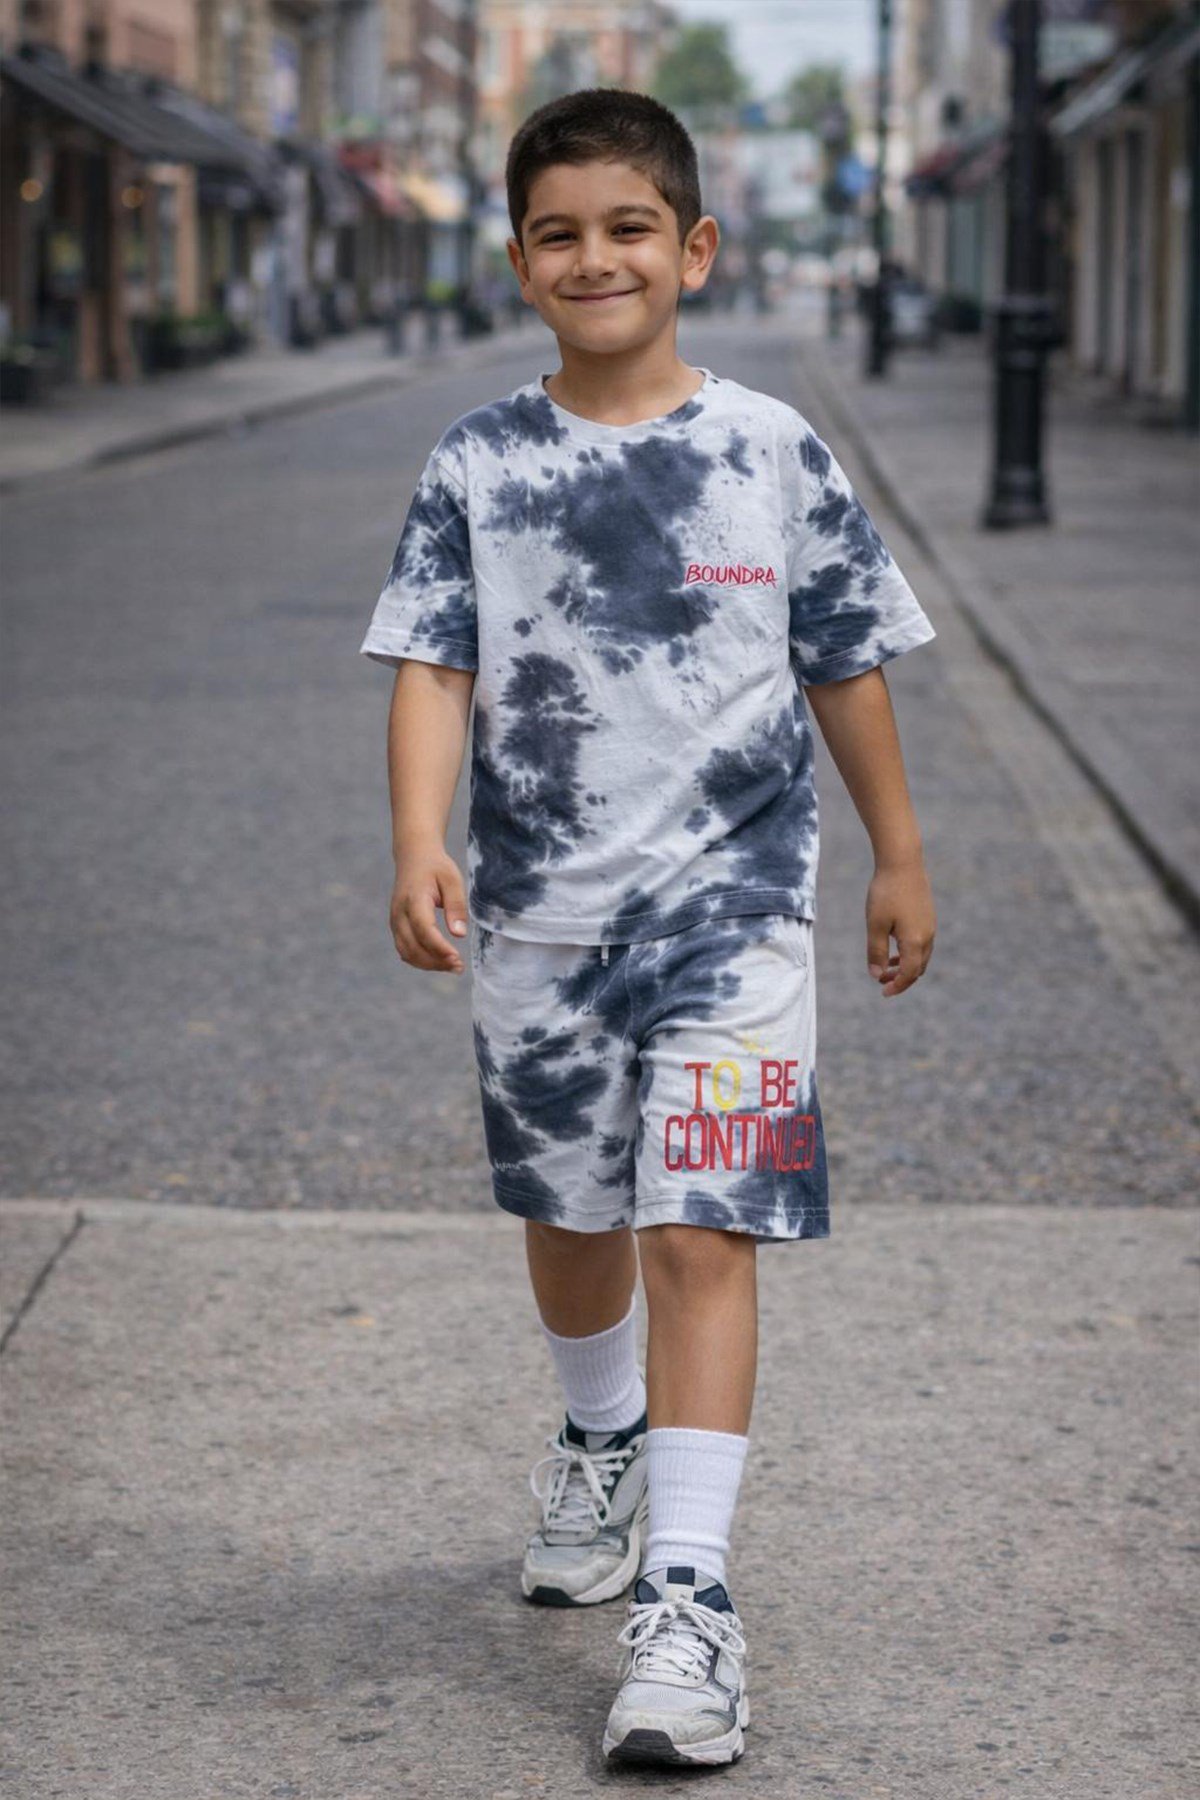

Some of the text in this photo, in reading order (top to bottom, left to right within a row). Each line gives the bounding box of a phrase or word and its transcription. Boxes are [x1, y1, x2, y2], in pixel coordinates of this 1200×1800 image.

[685, 564, 777, 588] BOUNDRA
[684, 1060, 798, 1110] TO BE
[664, 1113, 816, 1172] CONTINUED
